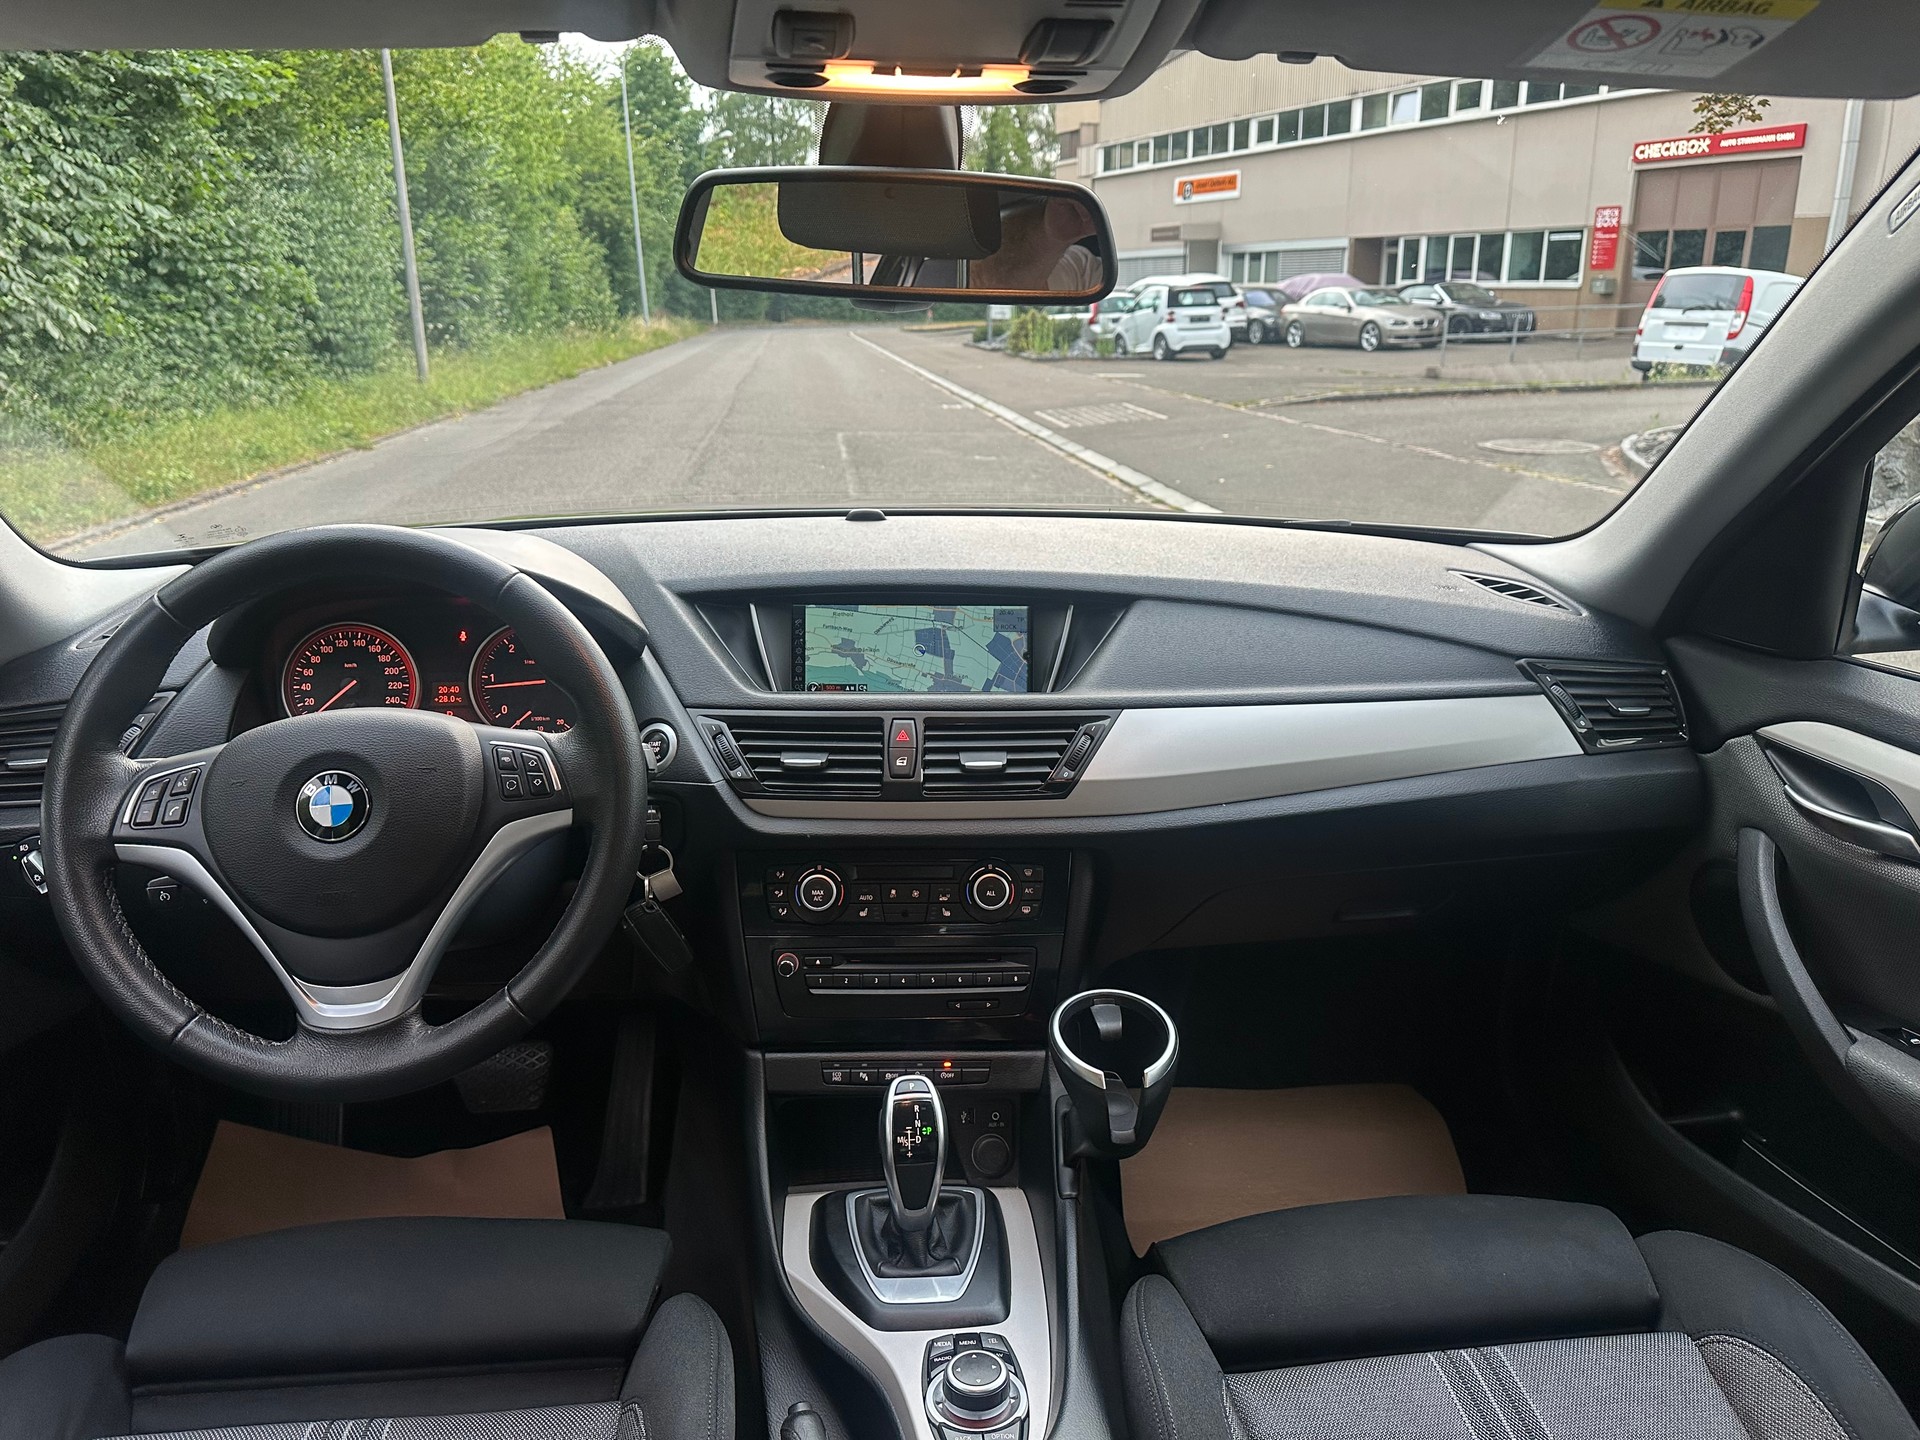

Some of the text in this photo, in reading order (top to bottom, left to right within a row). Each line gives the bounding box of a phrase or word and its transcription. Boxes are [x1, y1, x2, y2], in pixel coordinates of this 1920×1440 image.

[1635, 137, 1712, 160] CHECKBOX
[301, 683, 311, 691] 40
[501, 705, 508, 714] 0
[304, 774, 361, 797] BMW
